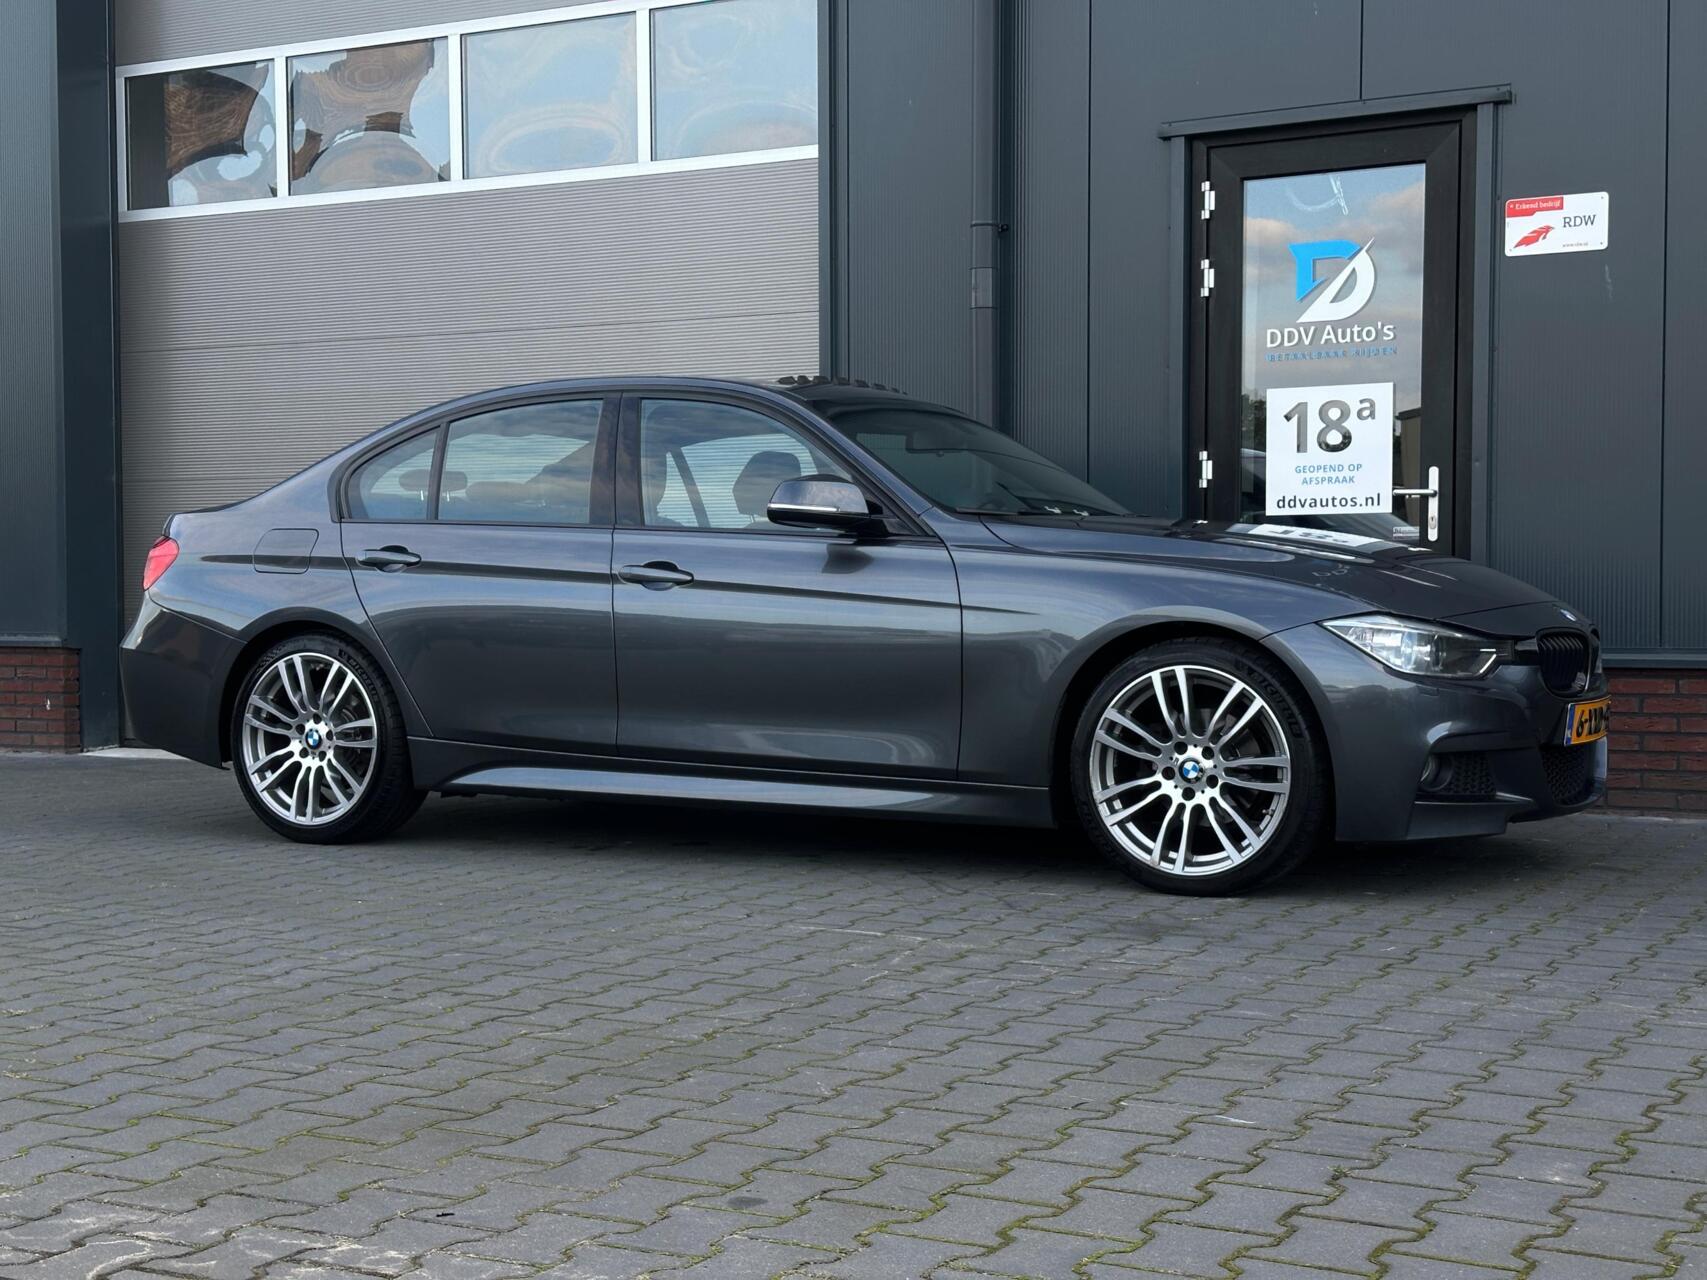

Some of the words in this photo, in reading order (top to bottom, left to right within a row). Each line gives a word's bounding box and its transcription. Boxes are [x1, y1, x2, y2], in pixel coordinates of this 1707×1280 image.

[1515, 202, 1538, 210] Erkend
[1539, 200, 1561, 209] bedrijf
[1563, 214, 1596, 228] RDW
[1266, 326, 1315, 347] DDV
[1321, 321, 1395, 345] Auto's
[1265, 349, 1347, 362] BETAALBAAR
[1351, 345, 1398, 358] RIJDEN
[1295, 464, 1344, 474] GEOPEND
[1347, 463, 1363, 472] OP
[1301, 475, 1356, 486] AFSPRAAK
[1276, 492, 1381, 509] ddvautos.nl
